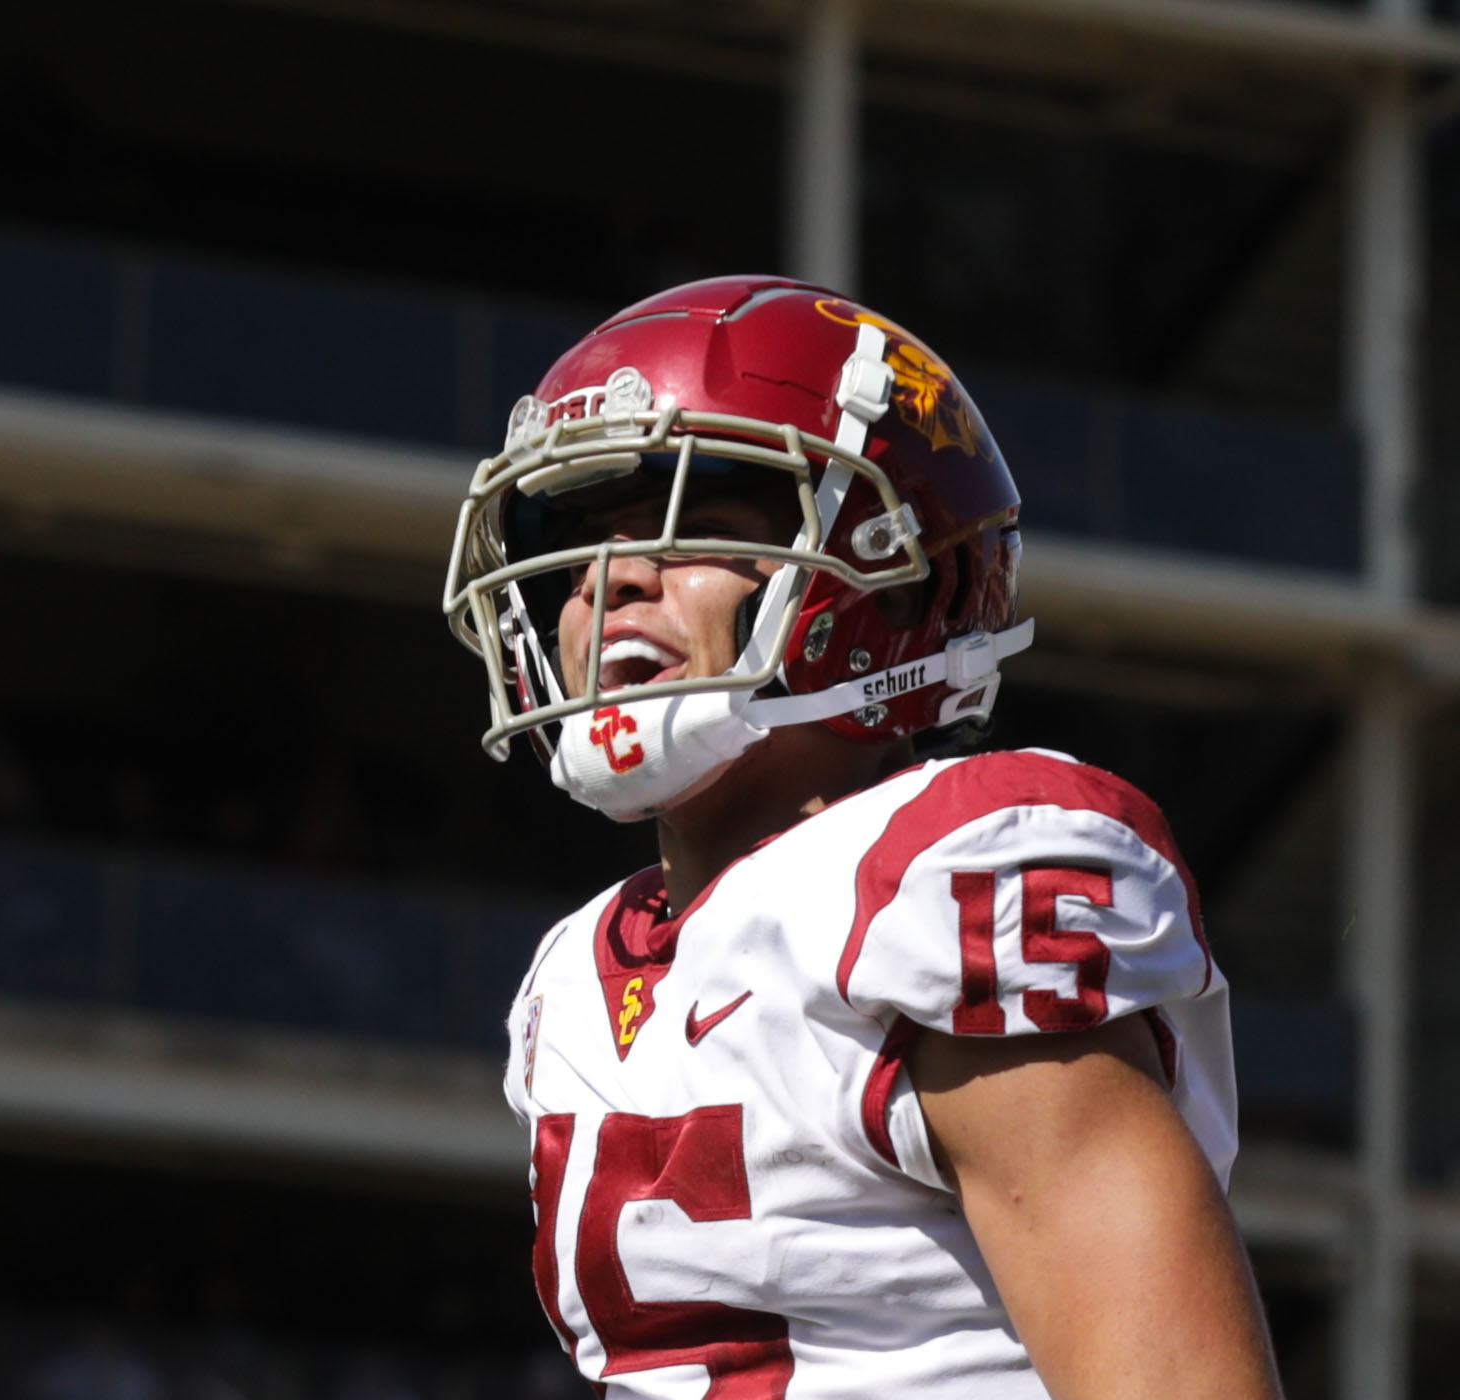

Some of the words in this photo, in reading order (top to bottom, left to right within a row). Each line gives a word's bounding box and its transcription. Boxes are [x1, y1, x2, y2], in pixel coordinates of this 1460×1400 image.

[863, 663, 926, 697] schutt
[951, 865, 1113, 1035] 15
[618, 976, 643, 1045] SC
